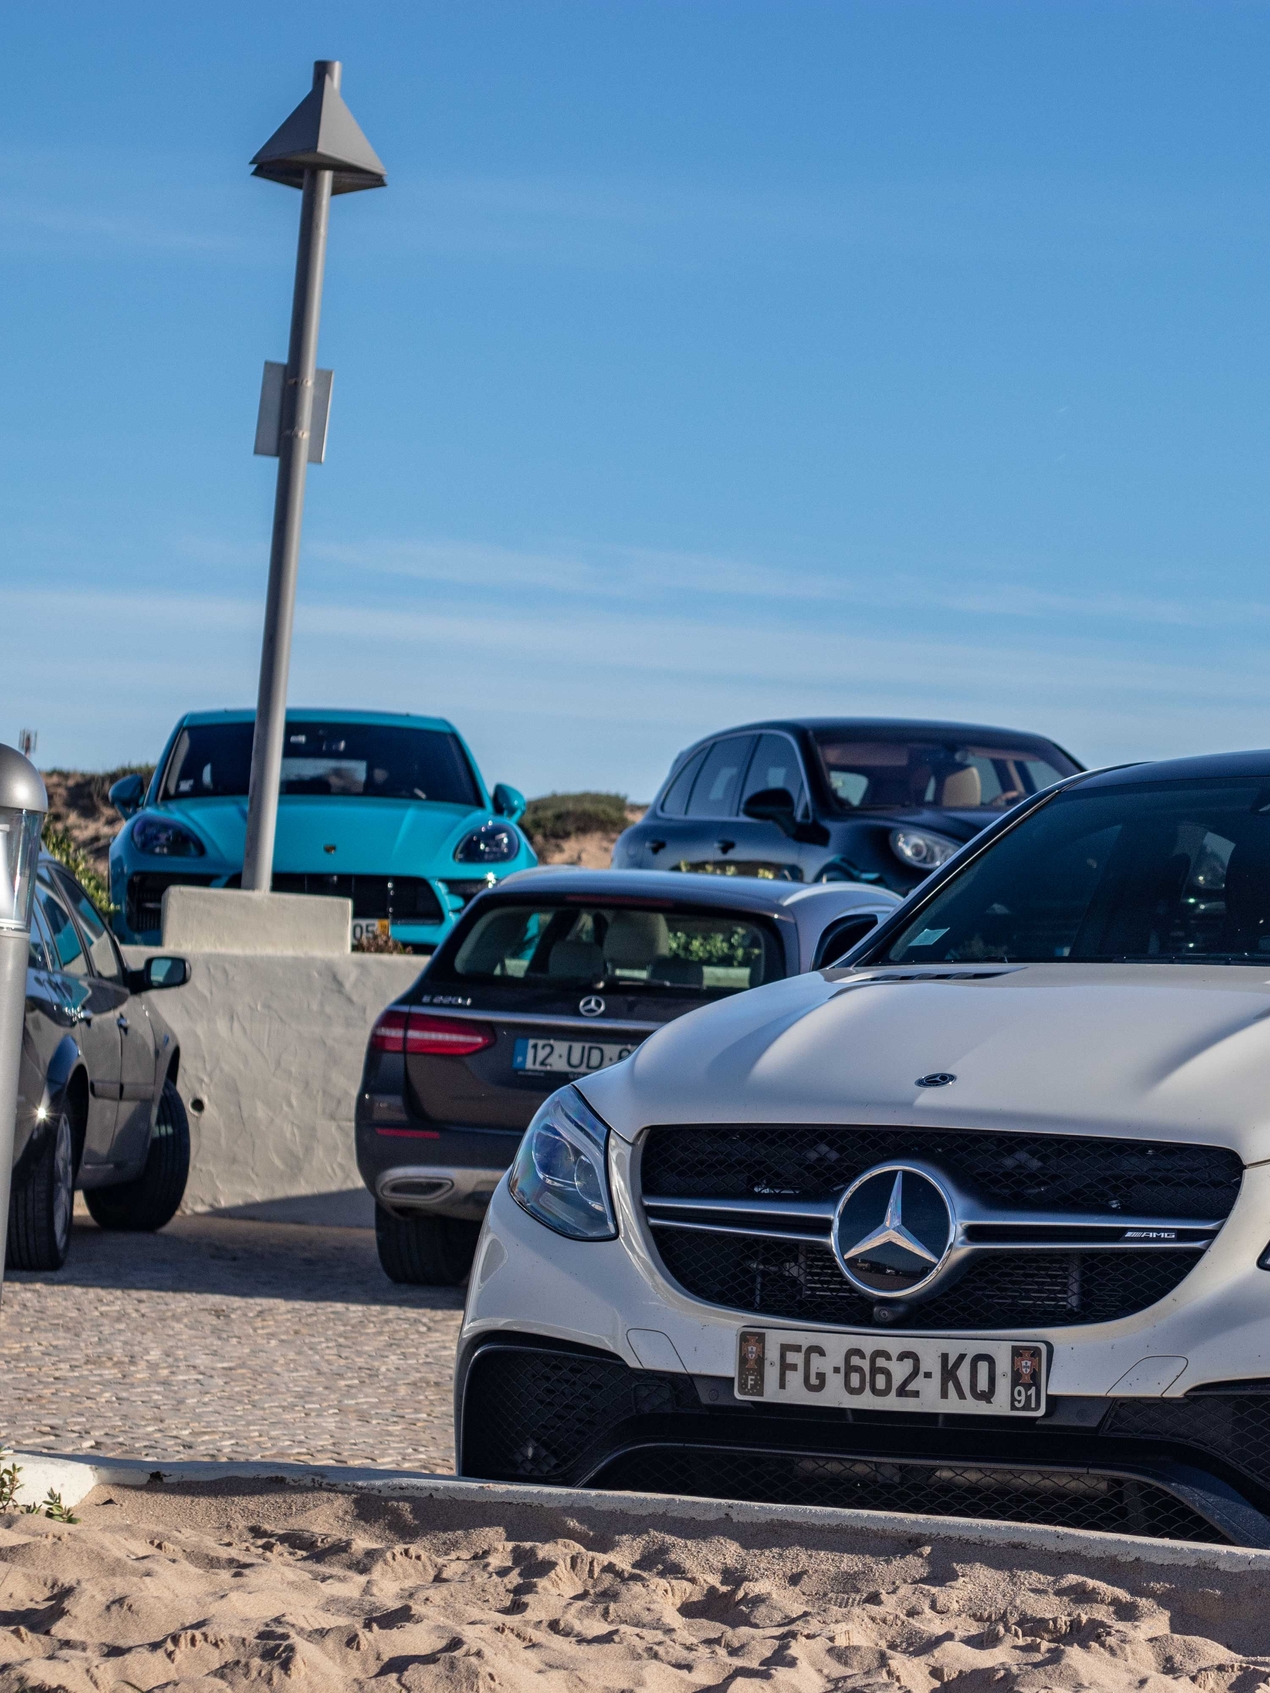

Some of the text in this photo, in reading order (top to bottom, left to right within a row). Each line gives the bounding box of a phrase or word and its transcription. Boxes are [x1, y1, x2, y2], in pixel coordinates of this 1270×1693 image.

[1140, 1231, 1176, 1239] AMG
[747, 1375, 755, 1389] F
[778, 1343, 997, 1405] FG-662-KQ
[1013, 1386, 1037, 1409] 91
